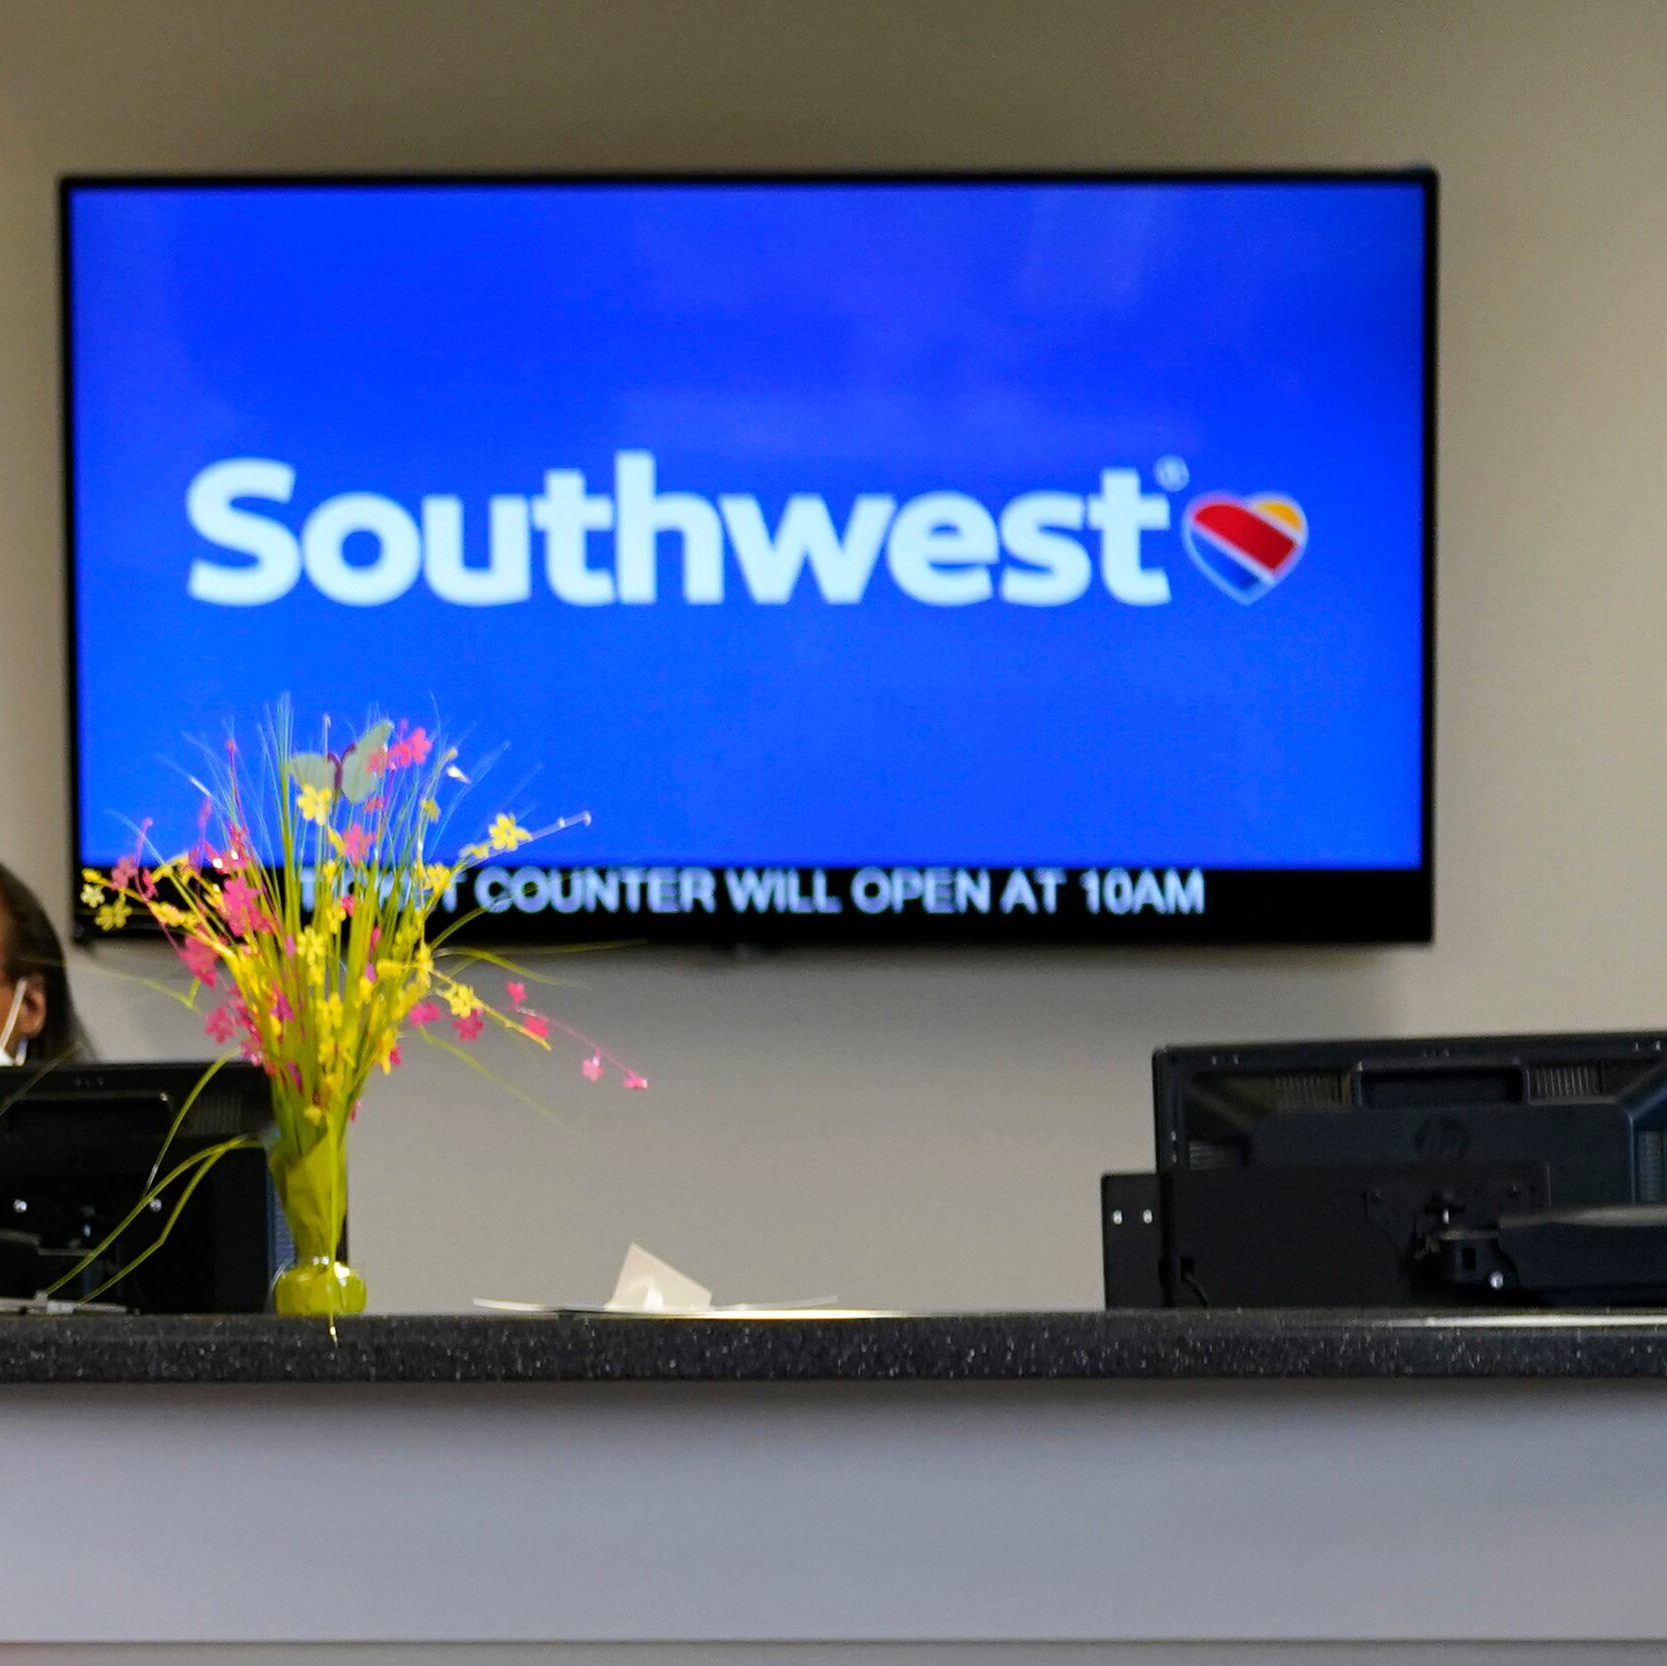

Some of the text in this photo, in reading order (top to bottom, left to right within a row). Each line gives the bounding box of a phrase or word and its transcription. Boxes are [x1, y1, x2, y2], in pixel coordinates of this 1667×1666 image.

[185, 450, 1173, 607] Southwest
[474, 867, 716, 914] COUNTER
[724, 868, 839, 914] WILL
[851, 868, 992, 914] OPEN
[1000, 868, 1065, 914] AT
[1080, 868, 1206, 914] 10AM
